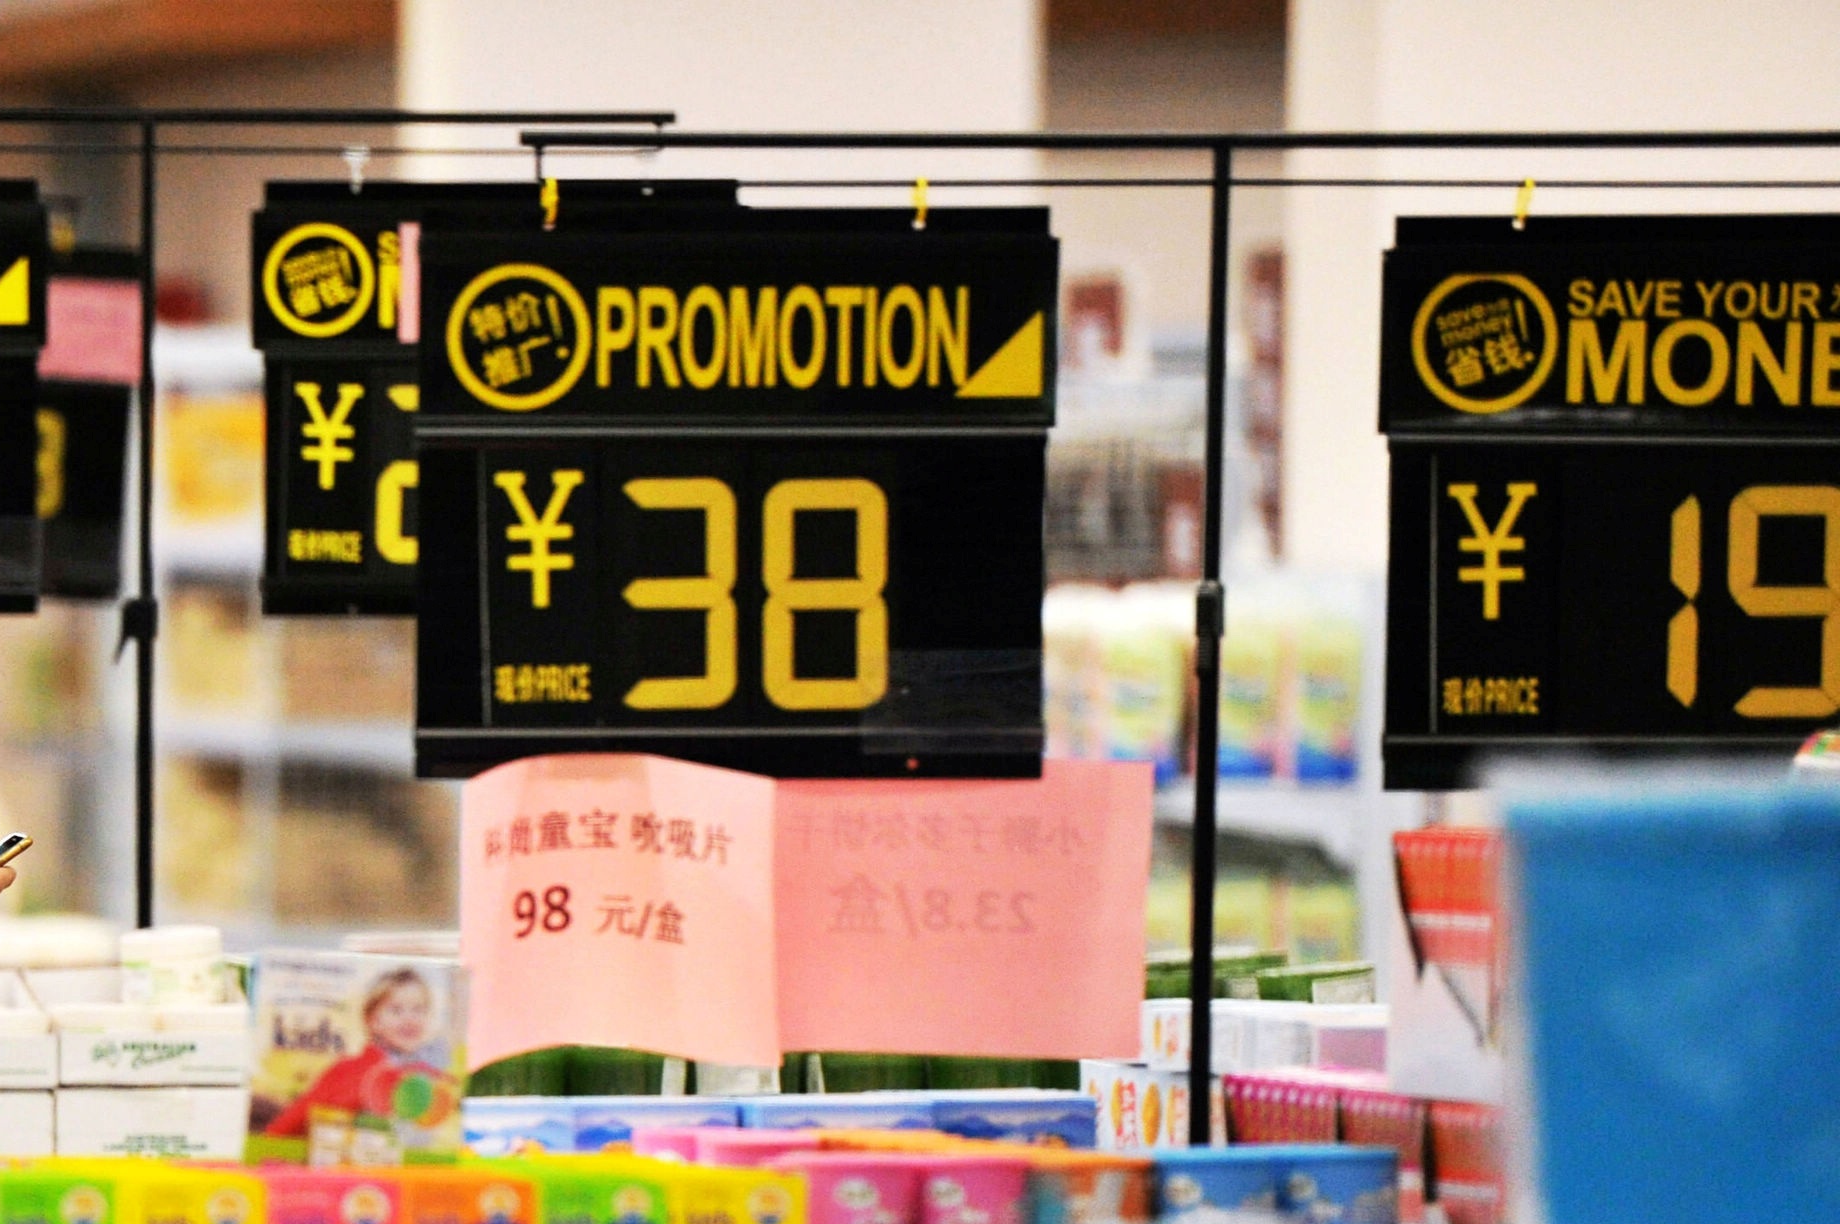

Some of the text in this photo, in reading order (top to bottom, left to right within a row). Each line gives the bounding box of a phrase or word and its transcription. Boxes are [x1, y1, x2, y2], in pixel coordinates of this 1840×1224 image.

[597, 286, 970, 390] PROMOTION
[1568, 280, 1681, 317] SAVE
[1696, 281, 1820, 319] YOUR
[494, 470, 584, 608] ¥
[622, 477, 889, 710] 38
[1448, 482, 1537, 620] ¥
[514, 885, 685, 946] 98 元/盒
